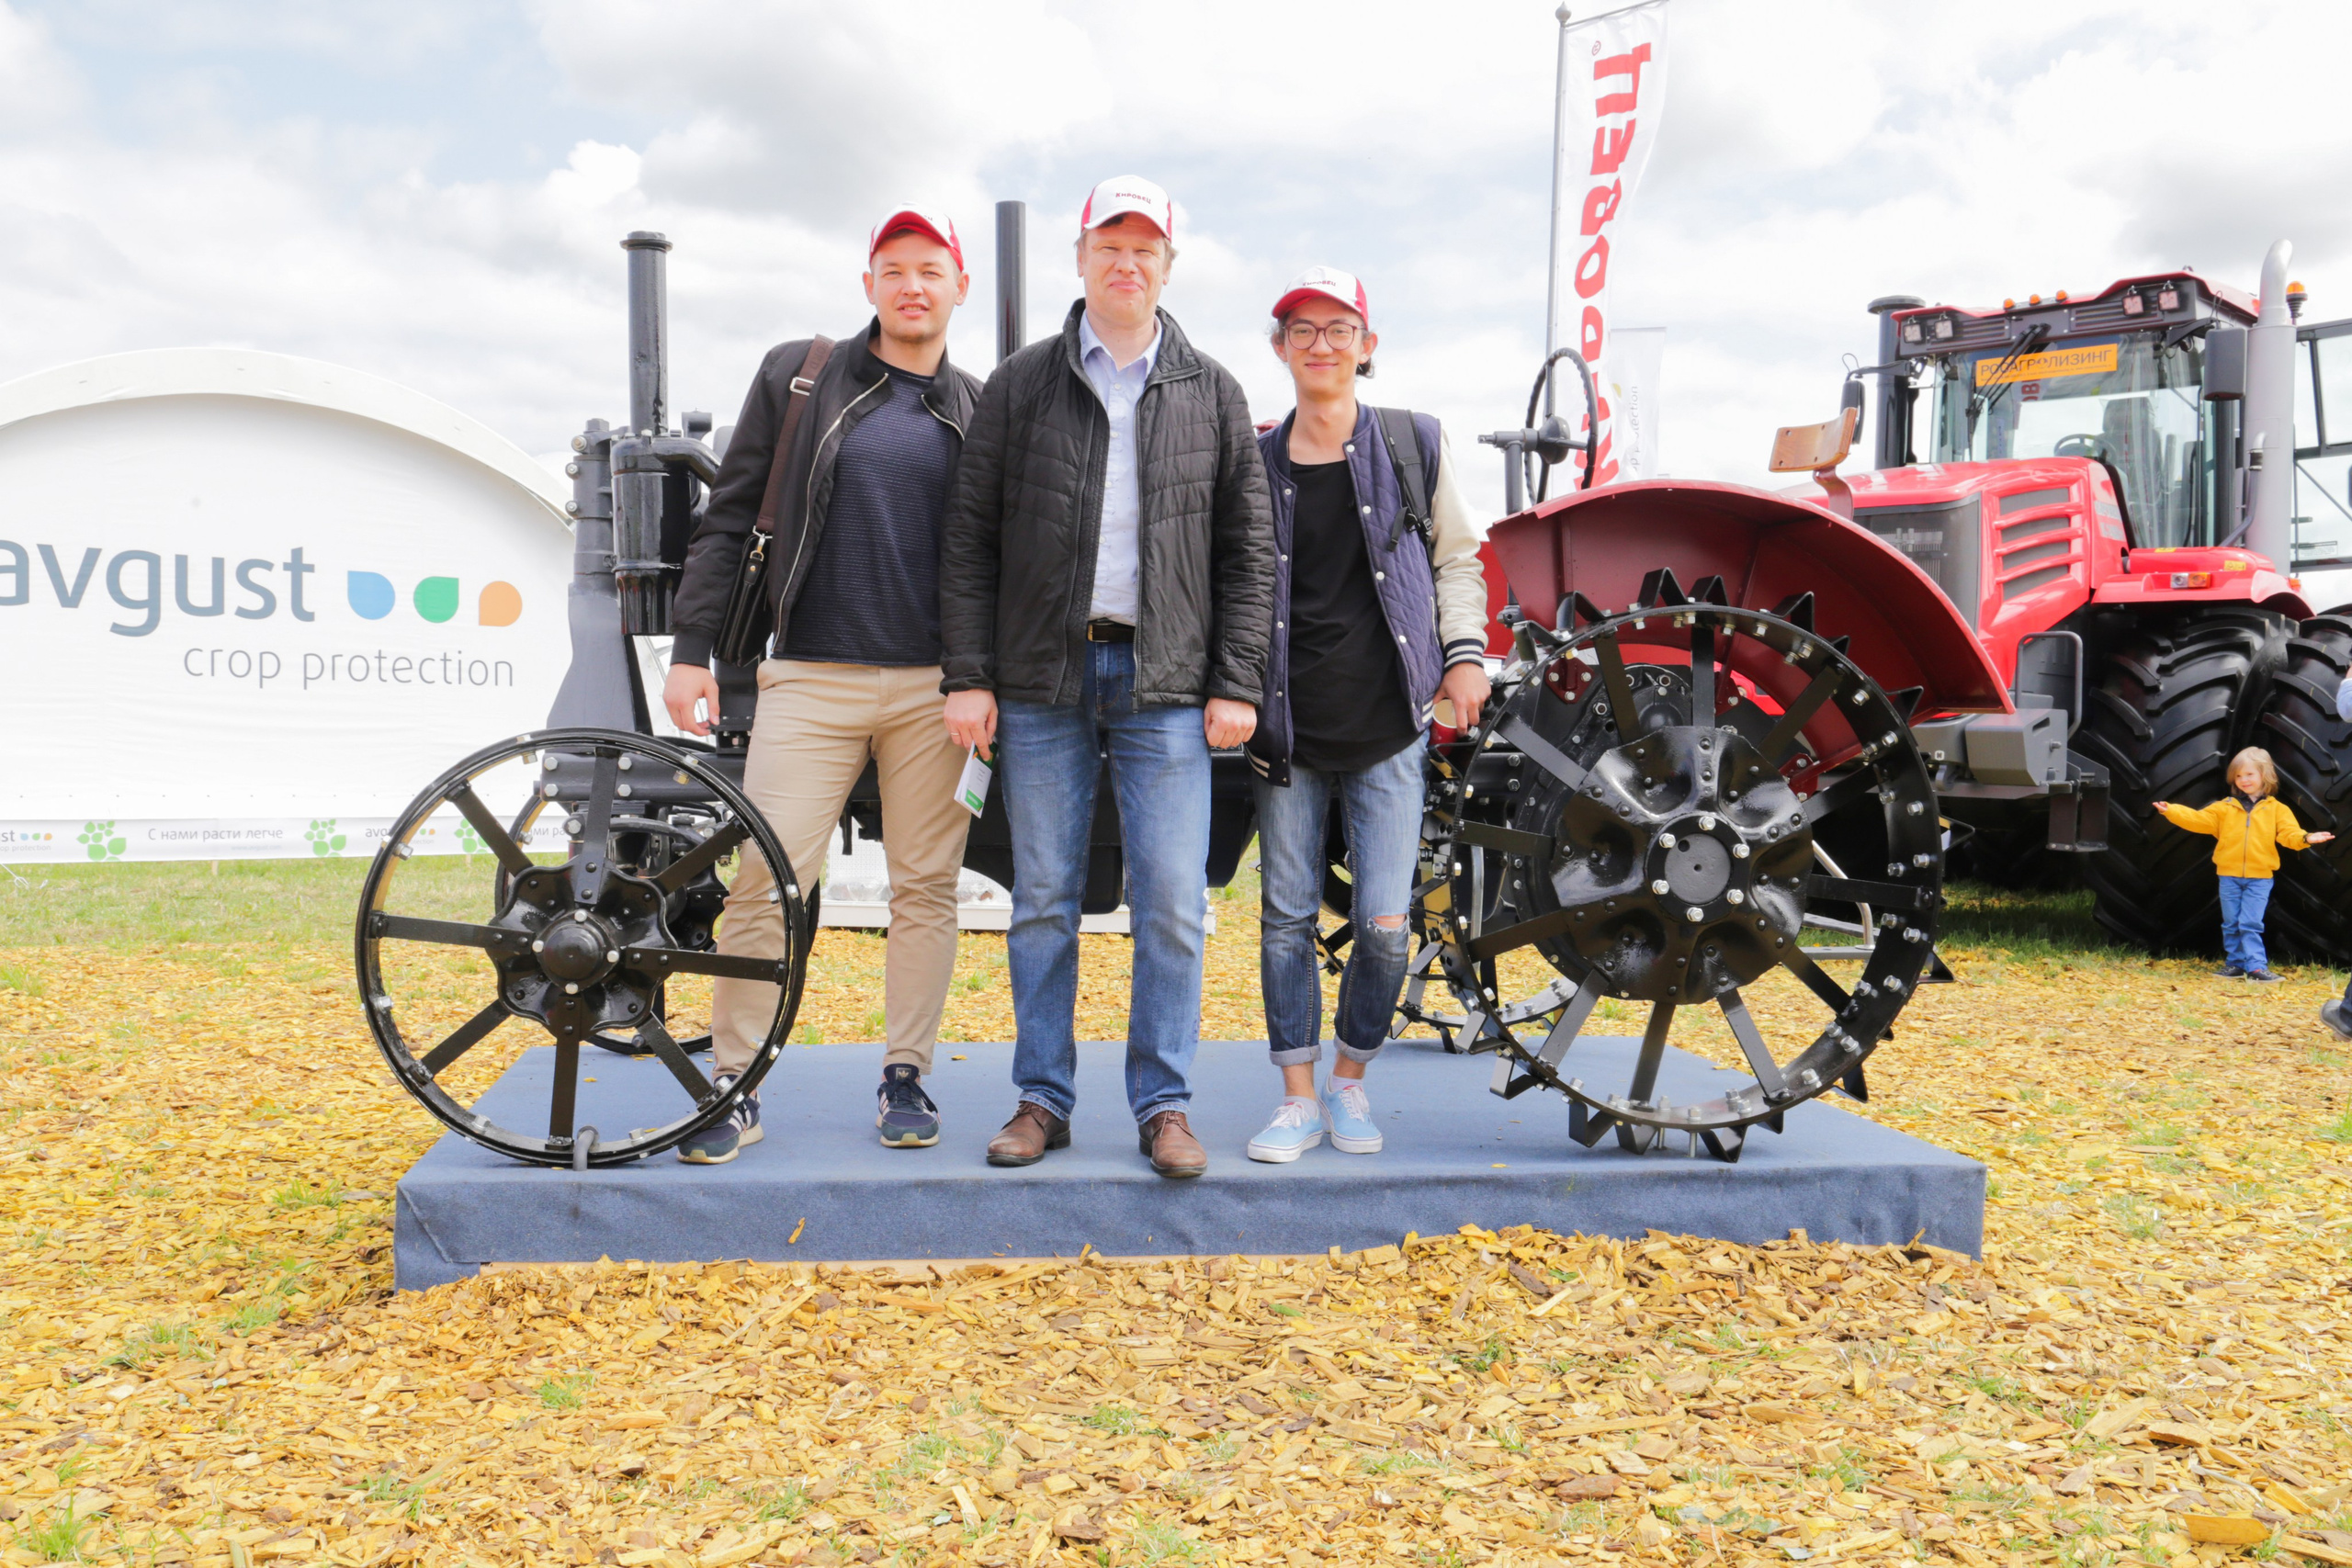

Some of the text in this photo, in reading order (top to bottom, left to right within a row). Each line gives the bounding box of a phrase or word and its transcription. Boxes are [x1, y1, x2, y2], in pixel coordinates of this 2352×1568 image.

[0, 539, 315, 637] avgust
[184, 648, 514, 690] crop protection
[148, 829, 284, 842] С нами расти легче
